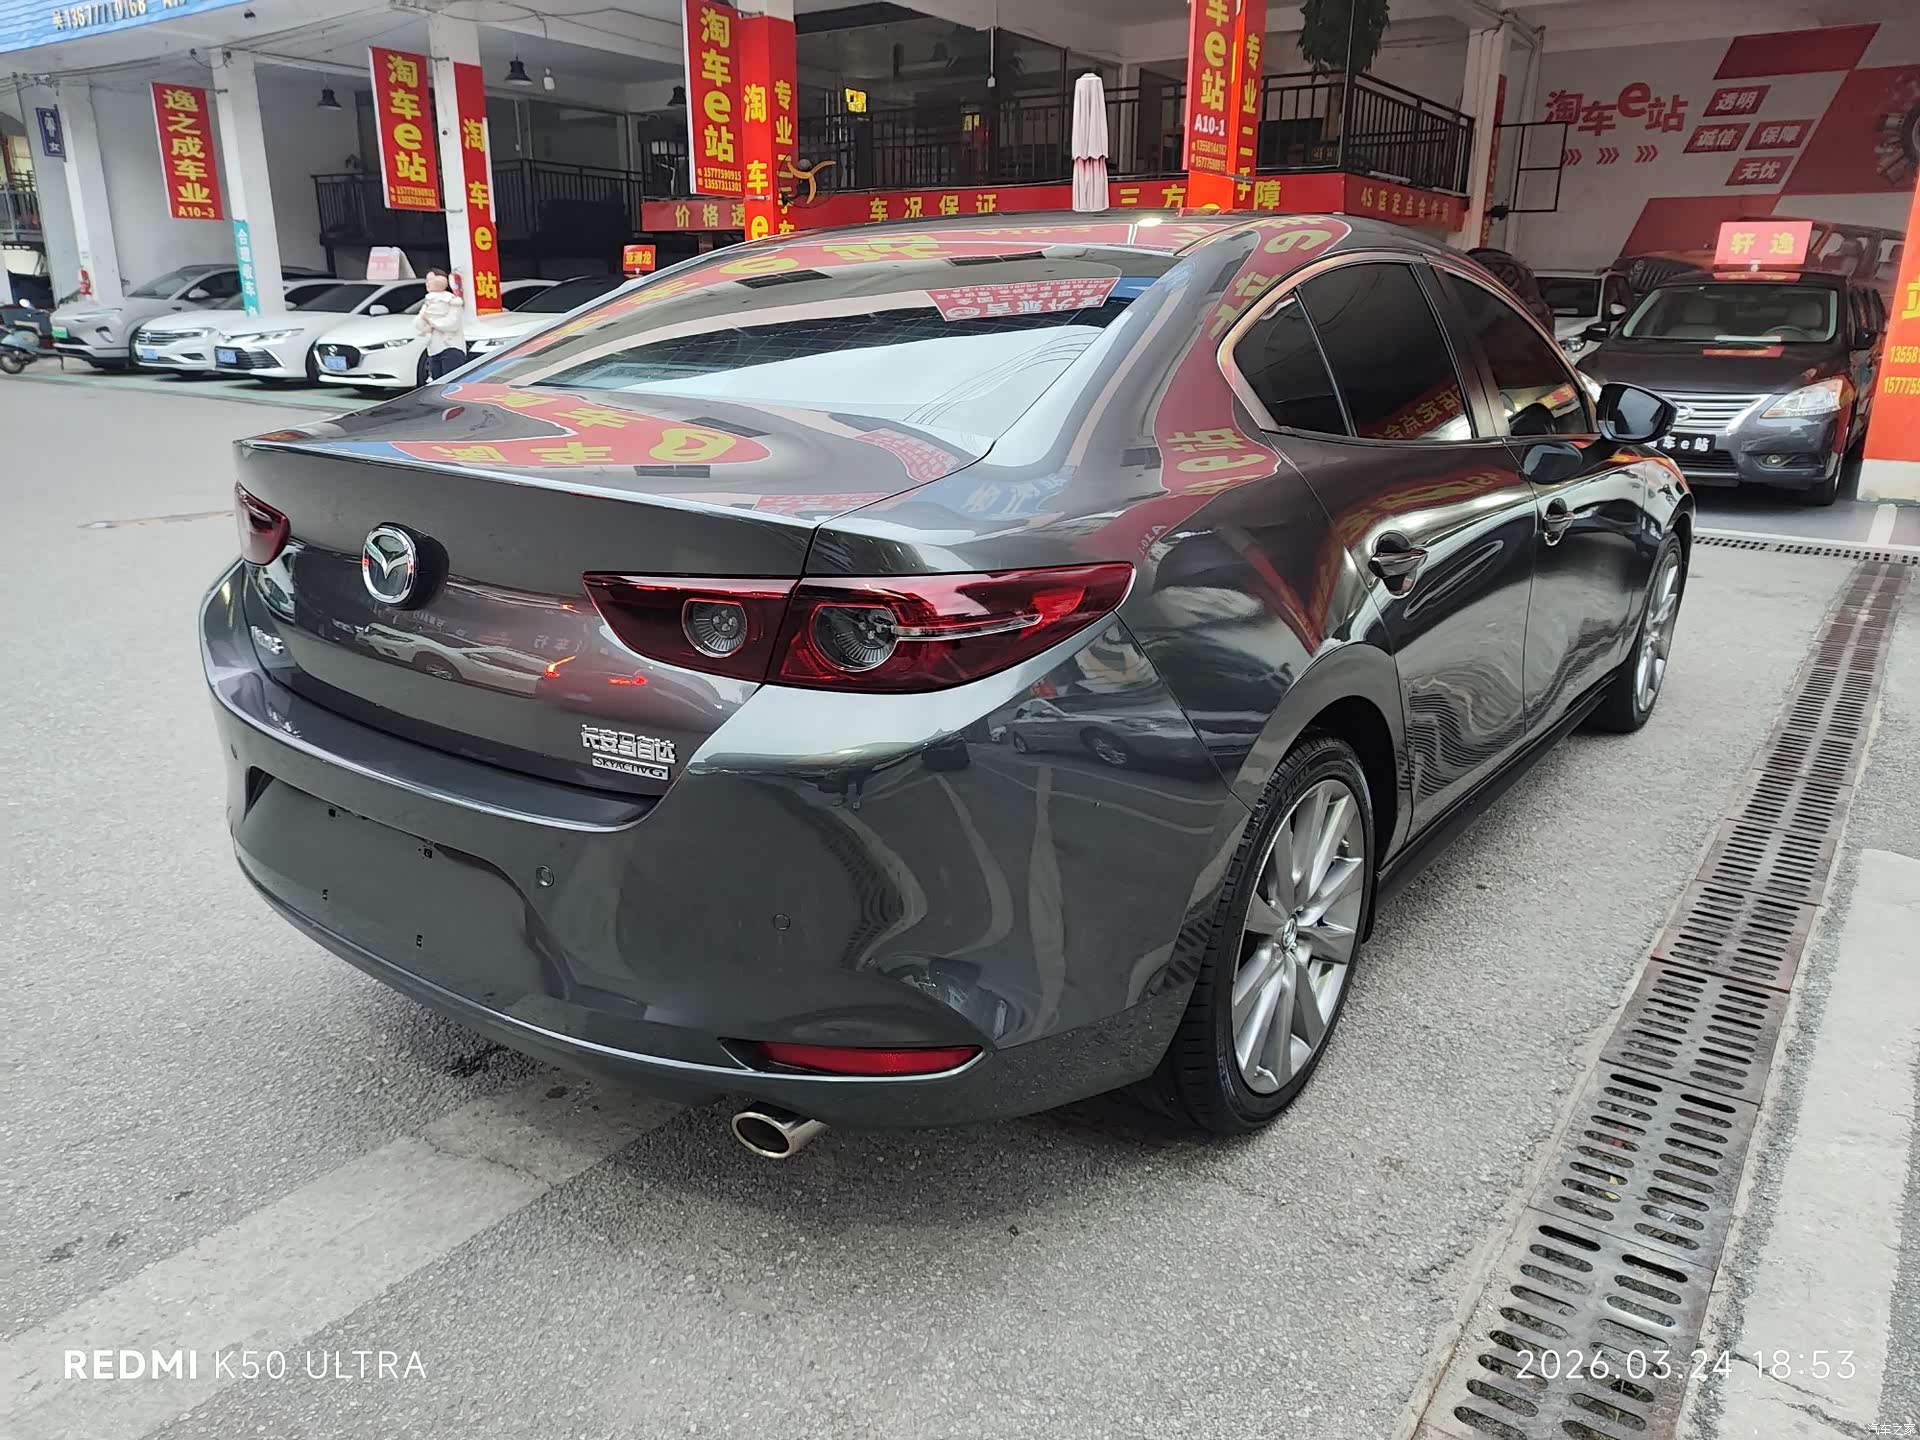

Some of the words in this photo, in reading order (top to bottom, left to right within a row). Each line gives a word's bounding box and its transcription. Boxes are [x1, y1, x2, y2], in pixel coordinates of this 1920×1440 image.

[700, 7, 735, 163] 淘车e站
[1544, 81, 1689, 136] 淘车e站
[1714, 90, 1763, 112] 透明
[387, 54, 429, 184] 淘车e站
[1194, 113, 1226, 137] A10-1
[1758, 124, 1801, 145] 保障
[163, 89, 212, 204] 逸之成车业
[743, 83, 770, 240] 淘车e
[1738, 159, 1781, 181] 无忧
[178, 206, 216, 218] A10-3
[462, 117, 498, 299] 淘车e站
[581, 723, 676, 764] 长安马自达
